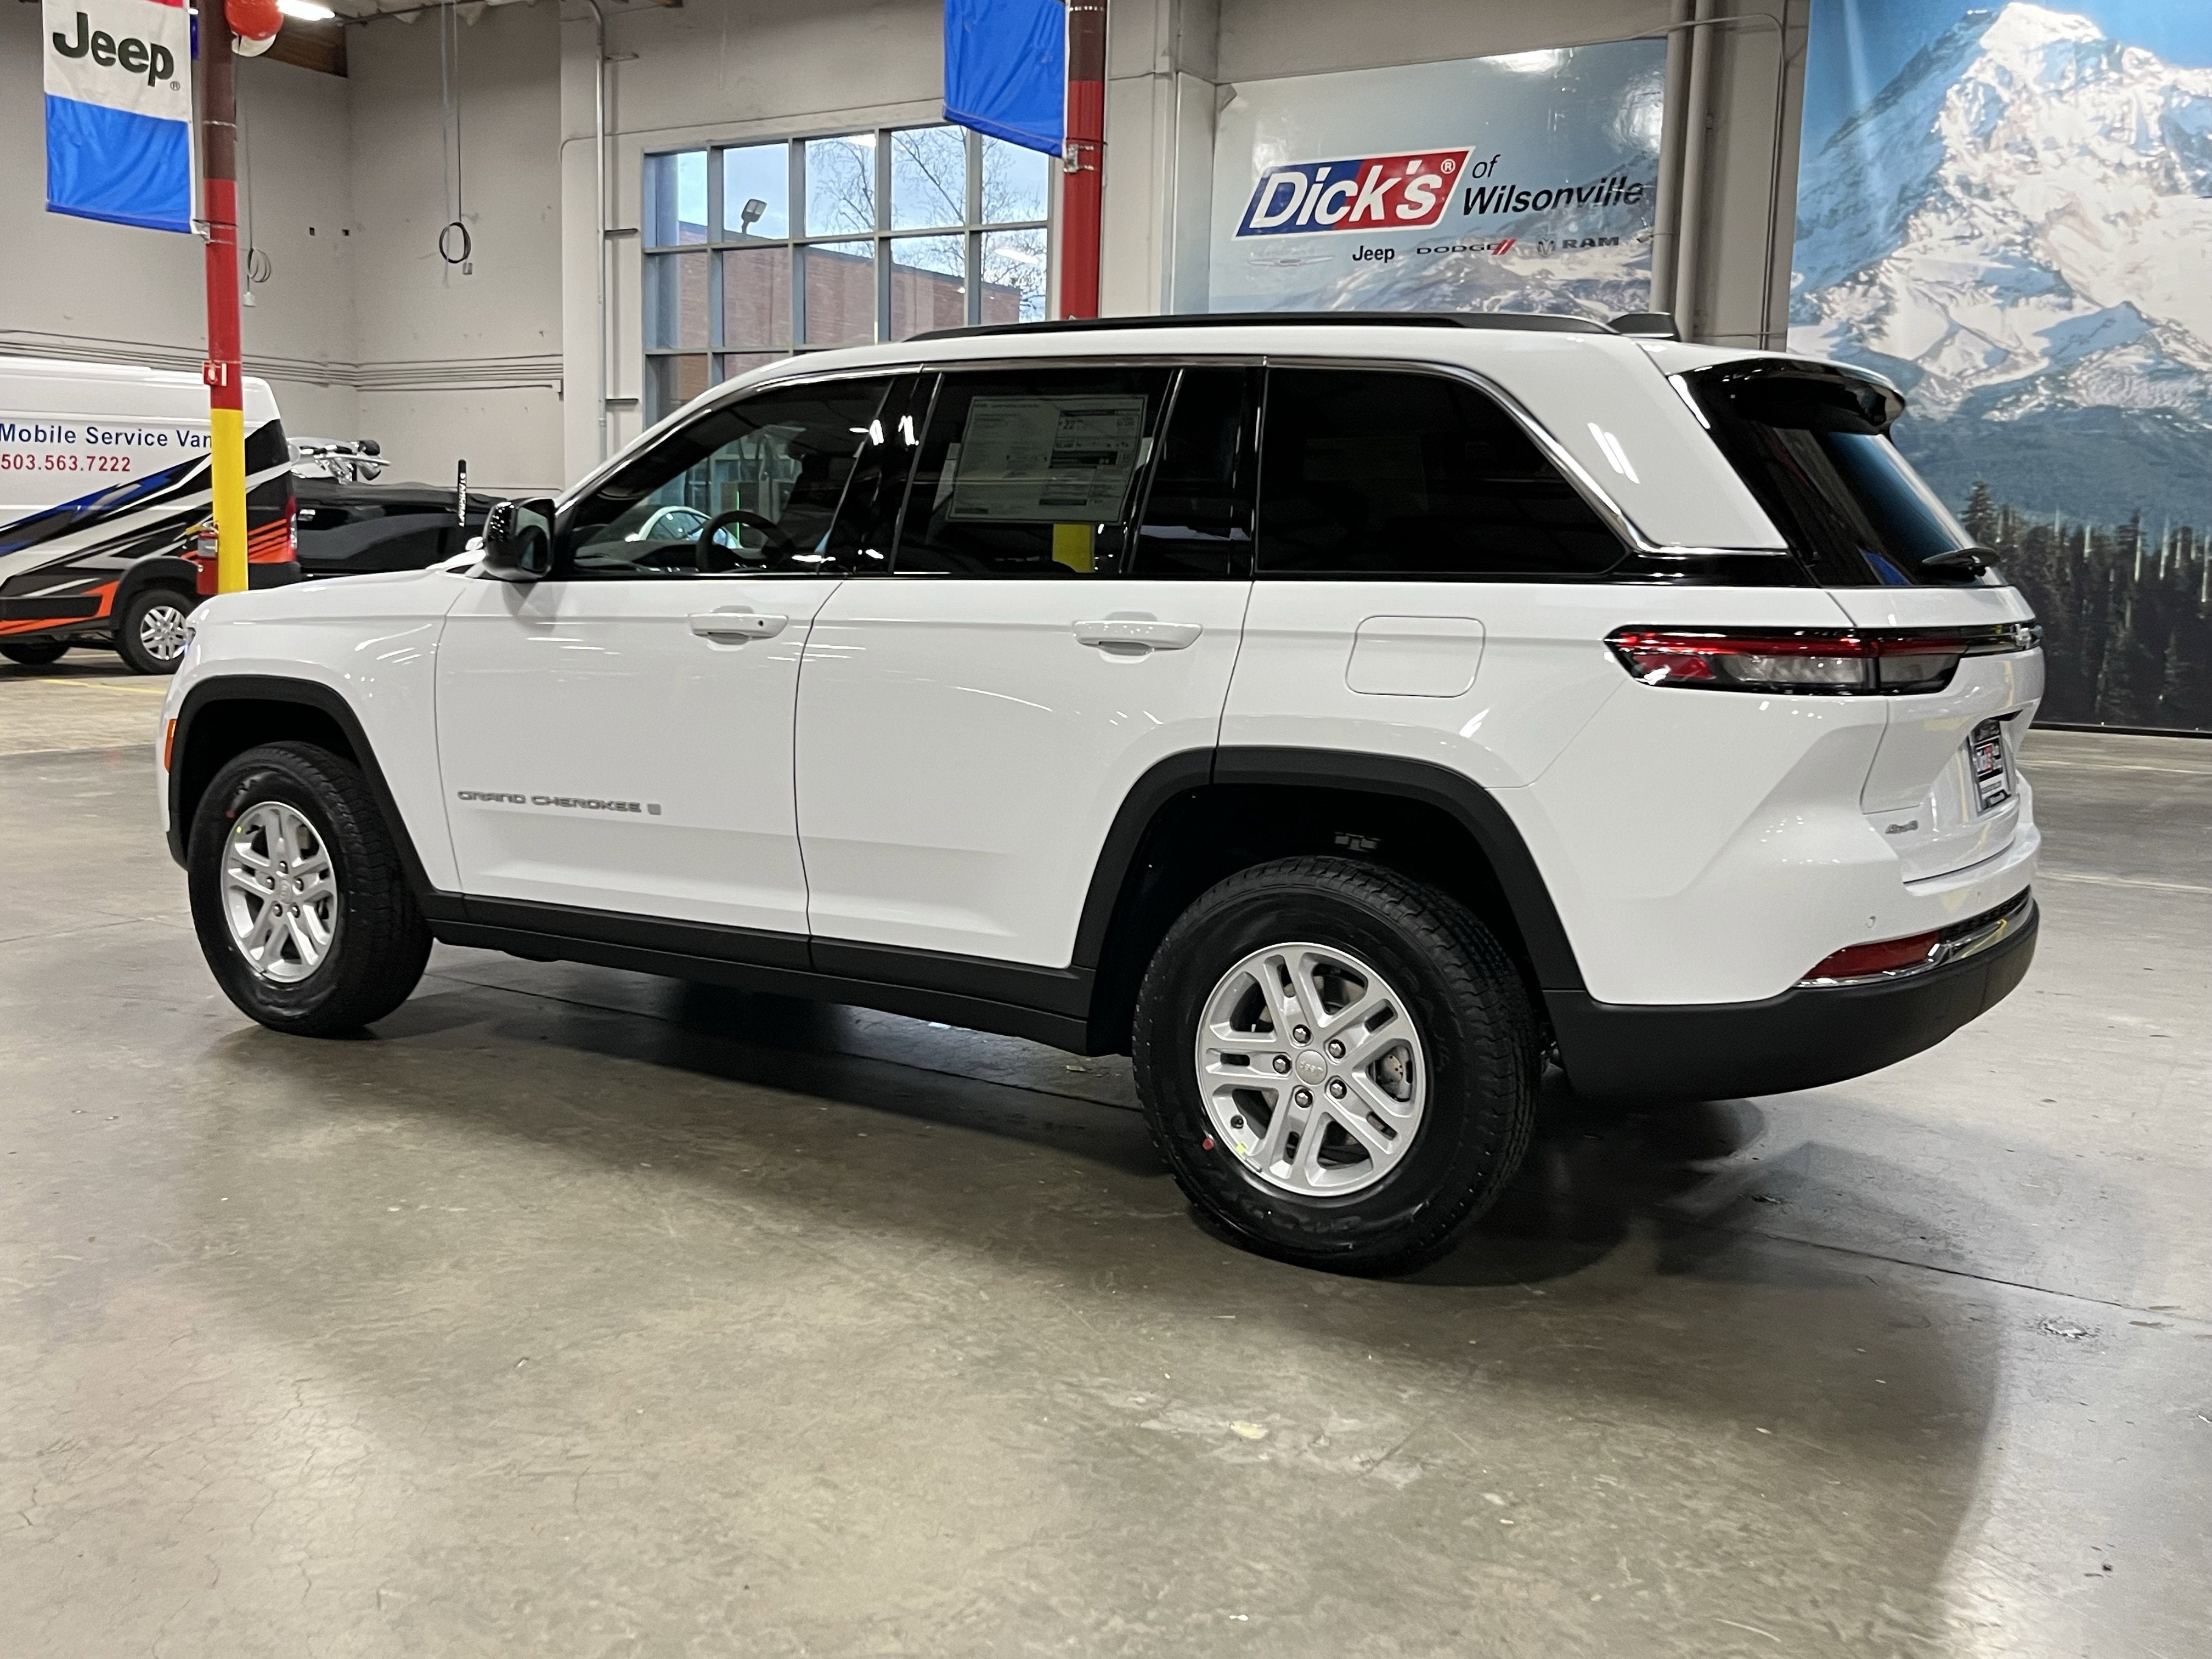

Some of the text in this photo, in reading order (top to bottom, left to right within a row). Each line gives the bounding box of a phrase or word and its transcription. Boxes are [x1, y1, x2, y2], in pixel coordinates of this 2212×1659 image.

[53, 12, 174, 87] Jeep
[1471, 154, 1501, 179] of
[1249, 159, 1443, 229] Dick's
[1463, 176, 1645, 216] Wilsonville
[1352, 245, 1395, 263] Jeep
[1417, 243, 1502, 255] DODGE
[1562, 236, 1620, 249] RAM
[0, 423, 76, 444] Mobile
[86, 426, 168, 447] Service
[1, 454, 131, 472] 503.563.7222
[458, 791, 642, 813] GRAND CHEROKEE
